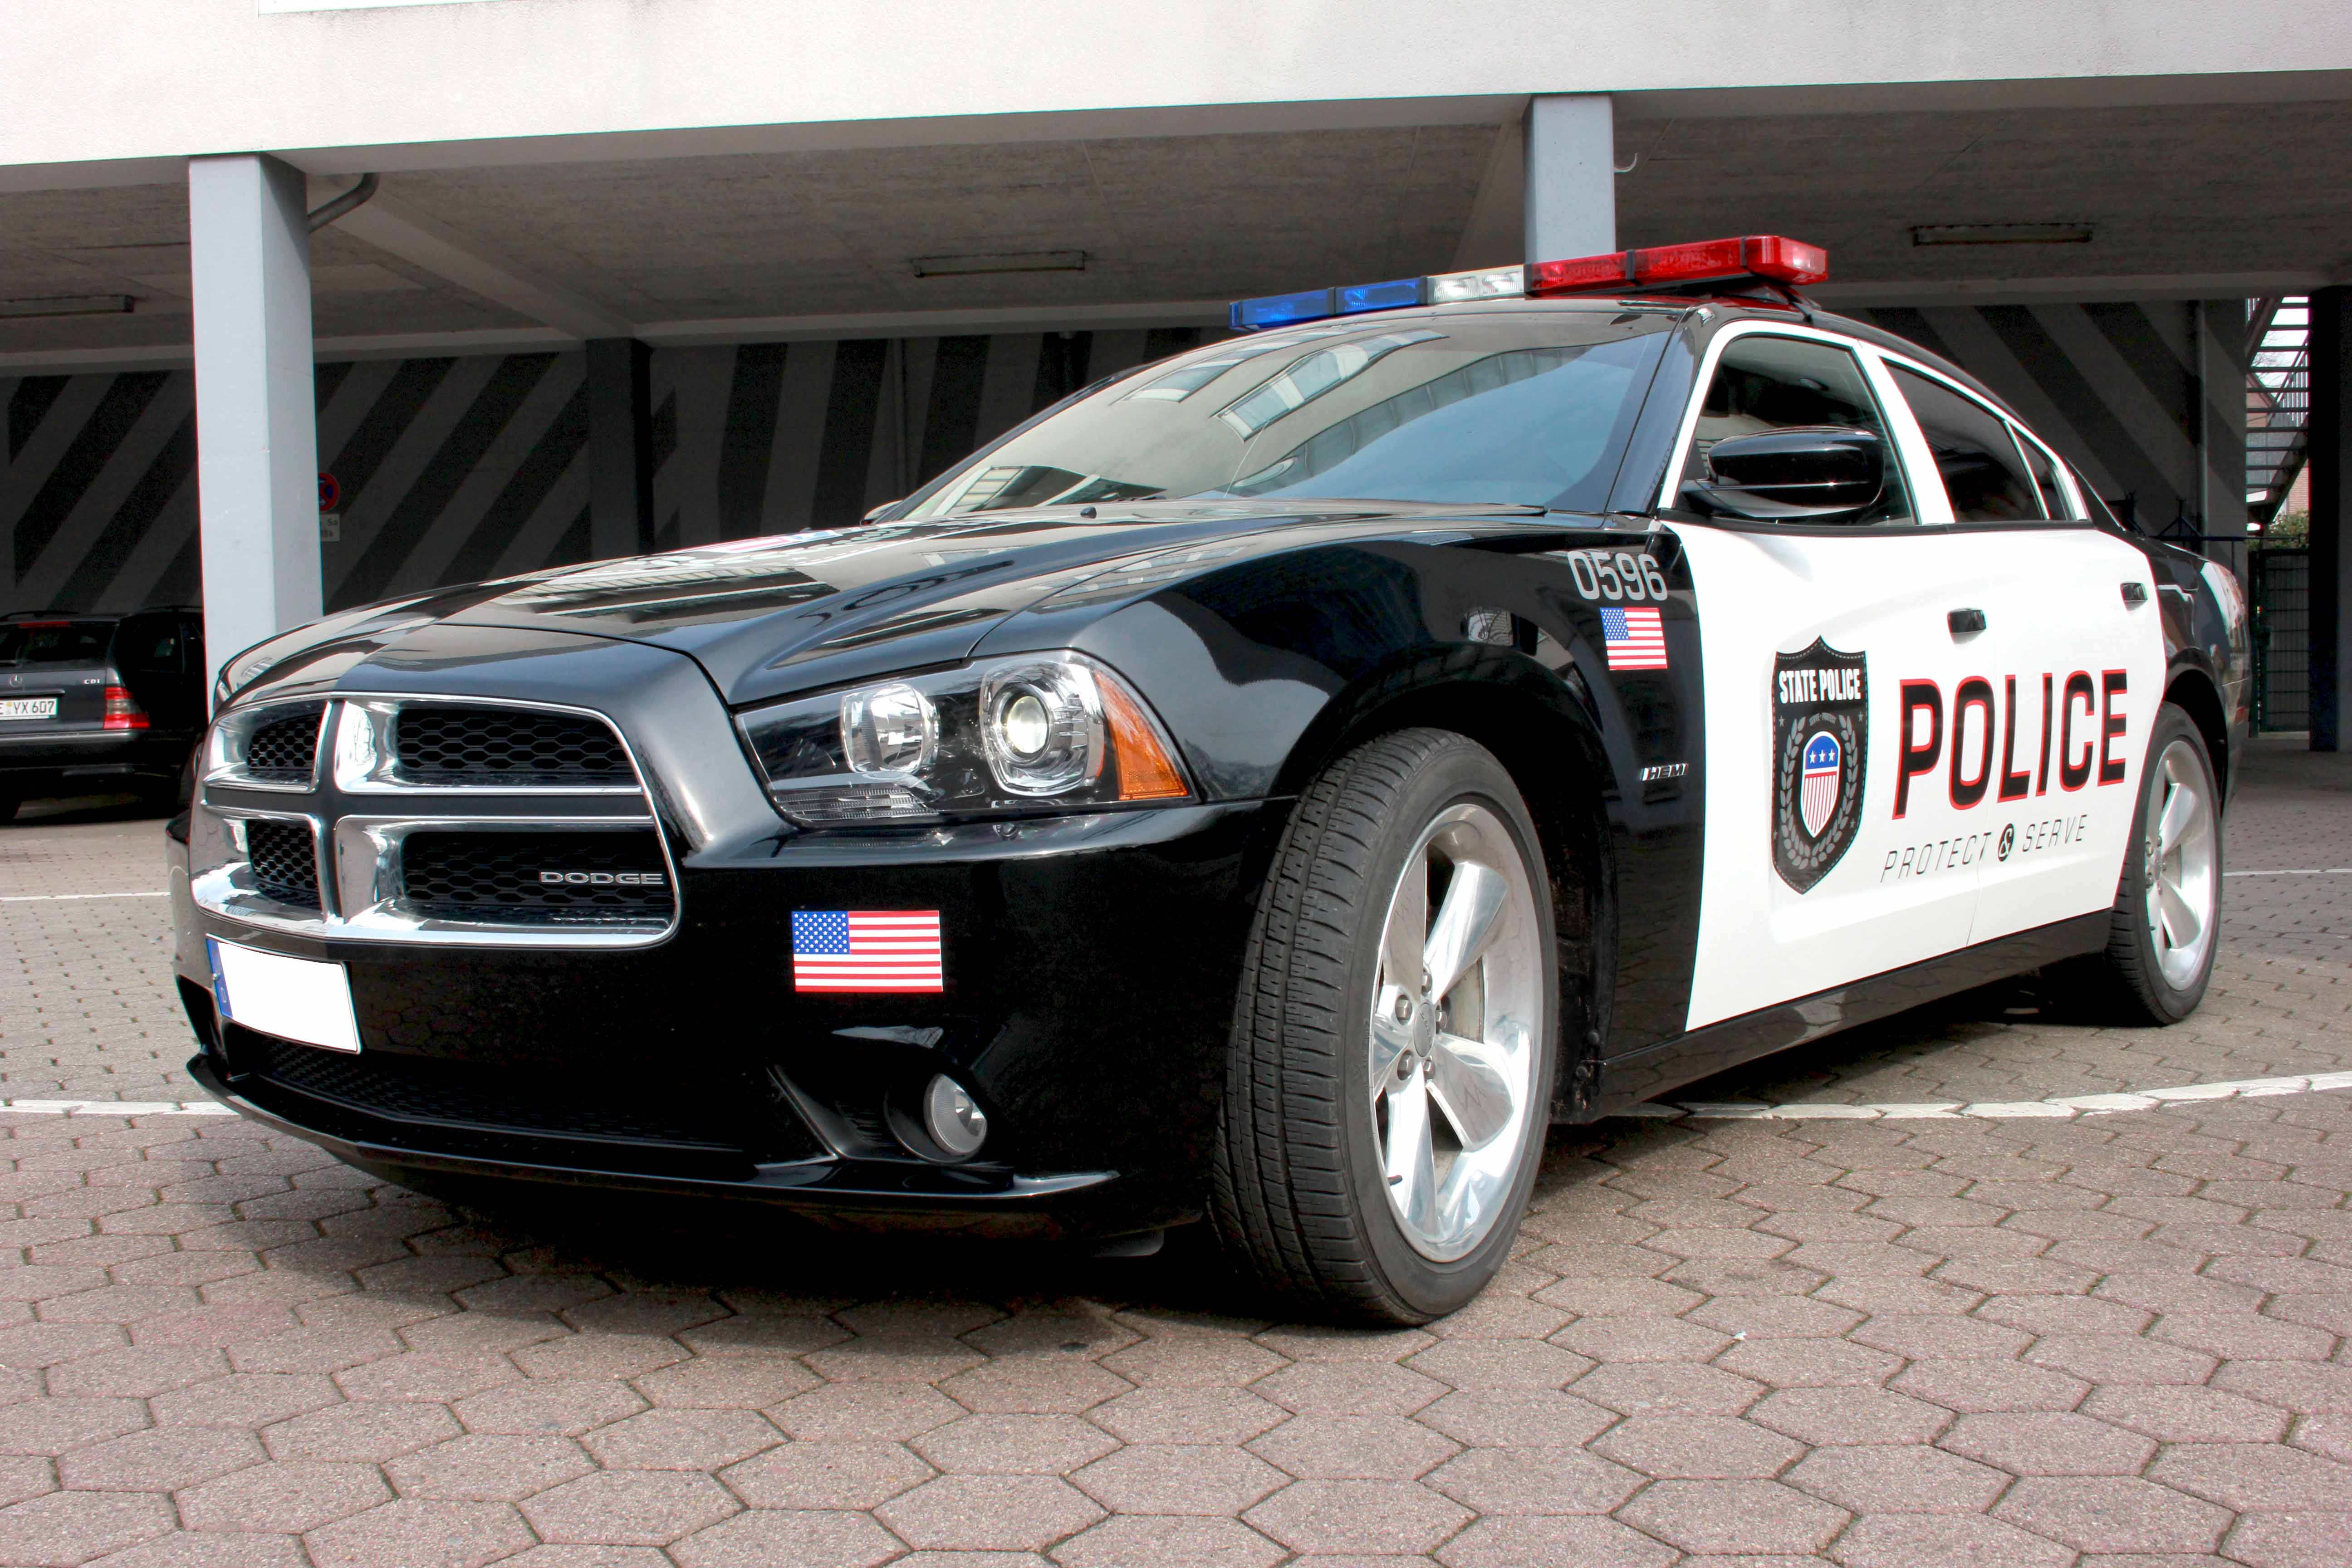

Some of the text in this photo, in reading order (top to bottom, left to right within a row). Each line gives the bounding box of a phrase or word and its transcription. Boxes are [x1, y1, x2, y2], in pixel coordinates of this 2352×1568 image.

[1567, 551, 1668, 601] 0596
[1779, 668, 1862, 704] STATE POLICE
[13, 701, 28, 714] YX
[32, 701, 55, 714] 607
[1891, 668, 2127, 820] POLICE
[1641, 763, 1689, 781] HEMI
[1880, 814, 2087, 883] PROTECT & SERVE
[539, 872, 664, 884] DODGE
